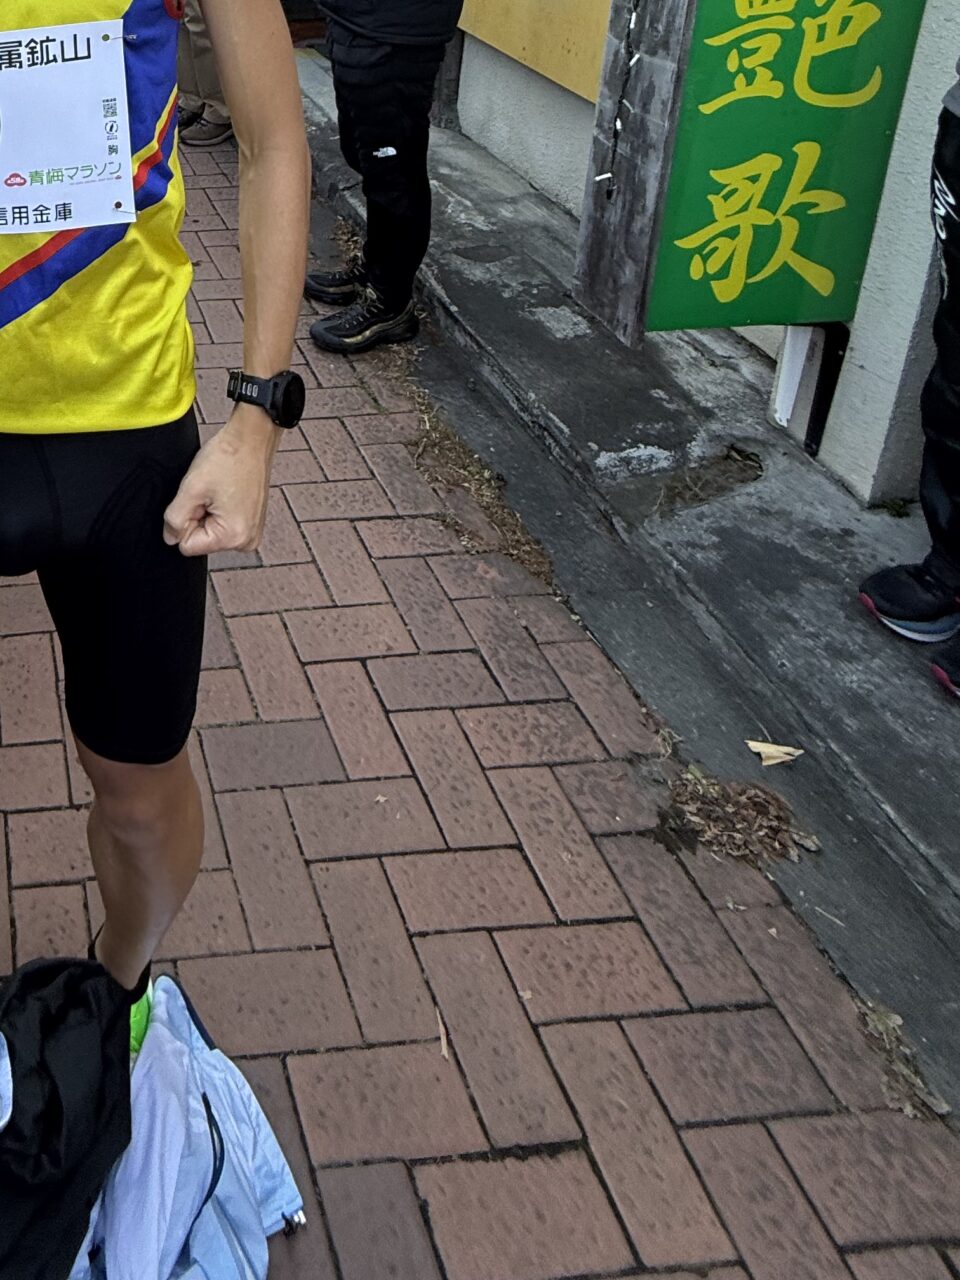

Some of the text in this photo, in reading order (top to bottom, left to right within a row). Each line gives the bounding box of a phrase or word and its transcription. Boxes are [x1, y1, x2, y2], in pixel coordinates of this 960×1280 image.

[28, 162, 122, 186] 青梅マラソン
